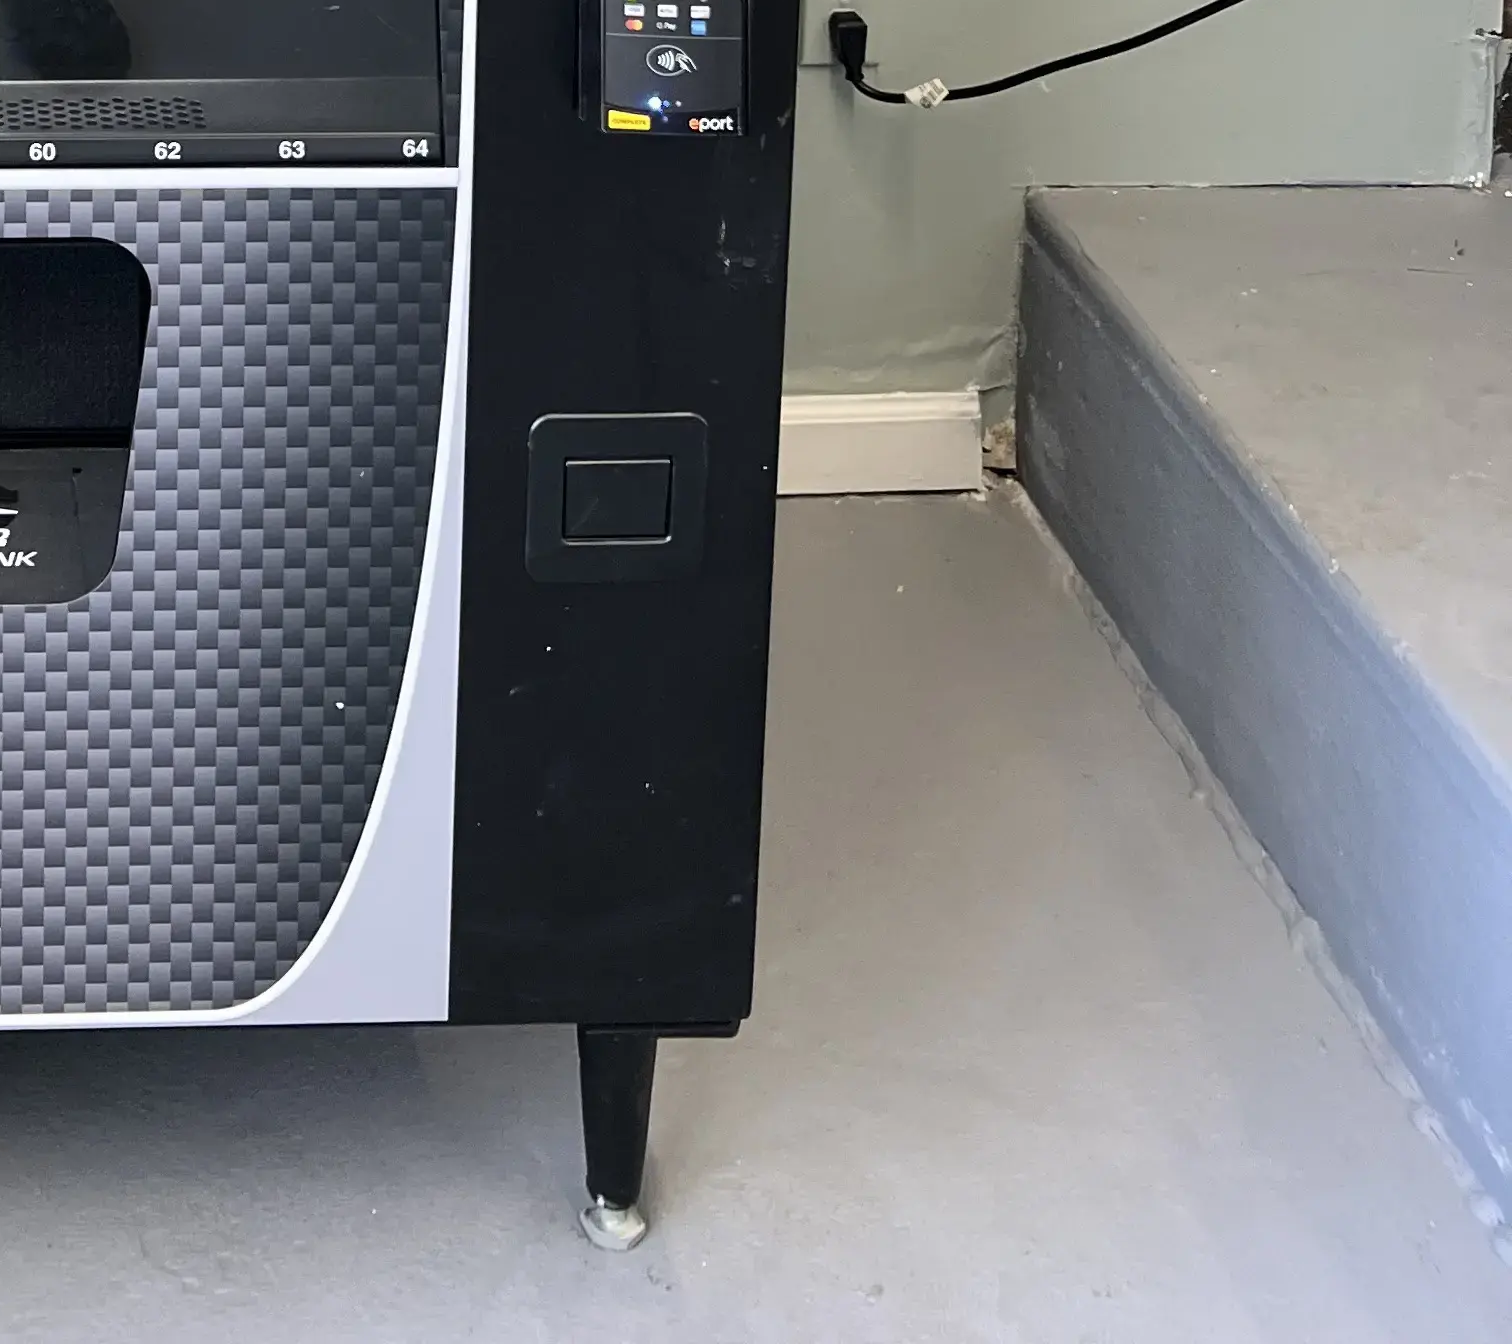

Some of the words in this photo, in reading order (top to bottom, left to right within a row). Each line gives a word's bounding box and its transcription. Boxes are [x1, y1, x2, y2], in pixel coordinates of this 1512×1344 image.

[689, 115, 734, 132] eport
[29, 142, 56, 161] 60
[154, 141, 181, 160] 62
[278, 140, 306, 159] 63
[402, 139, 429, 158] 64
